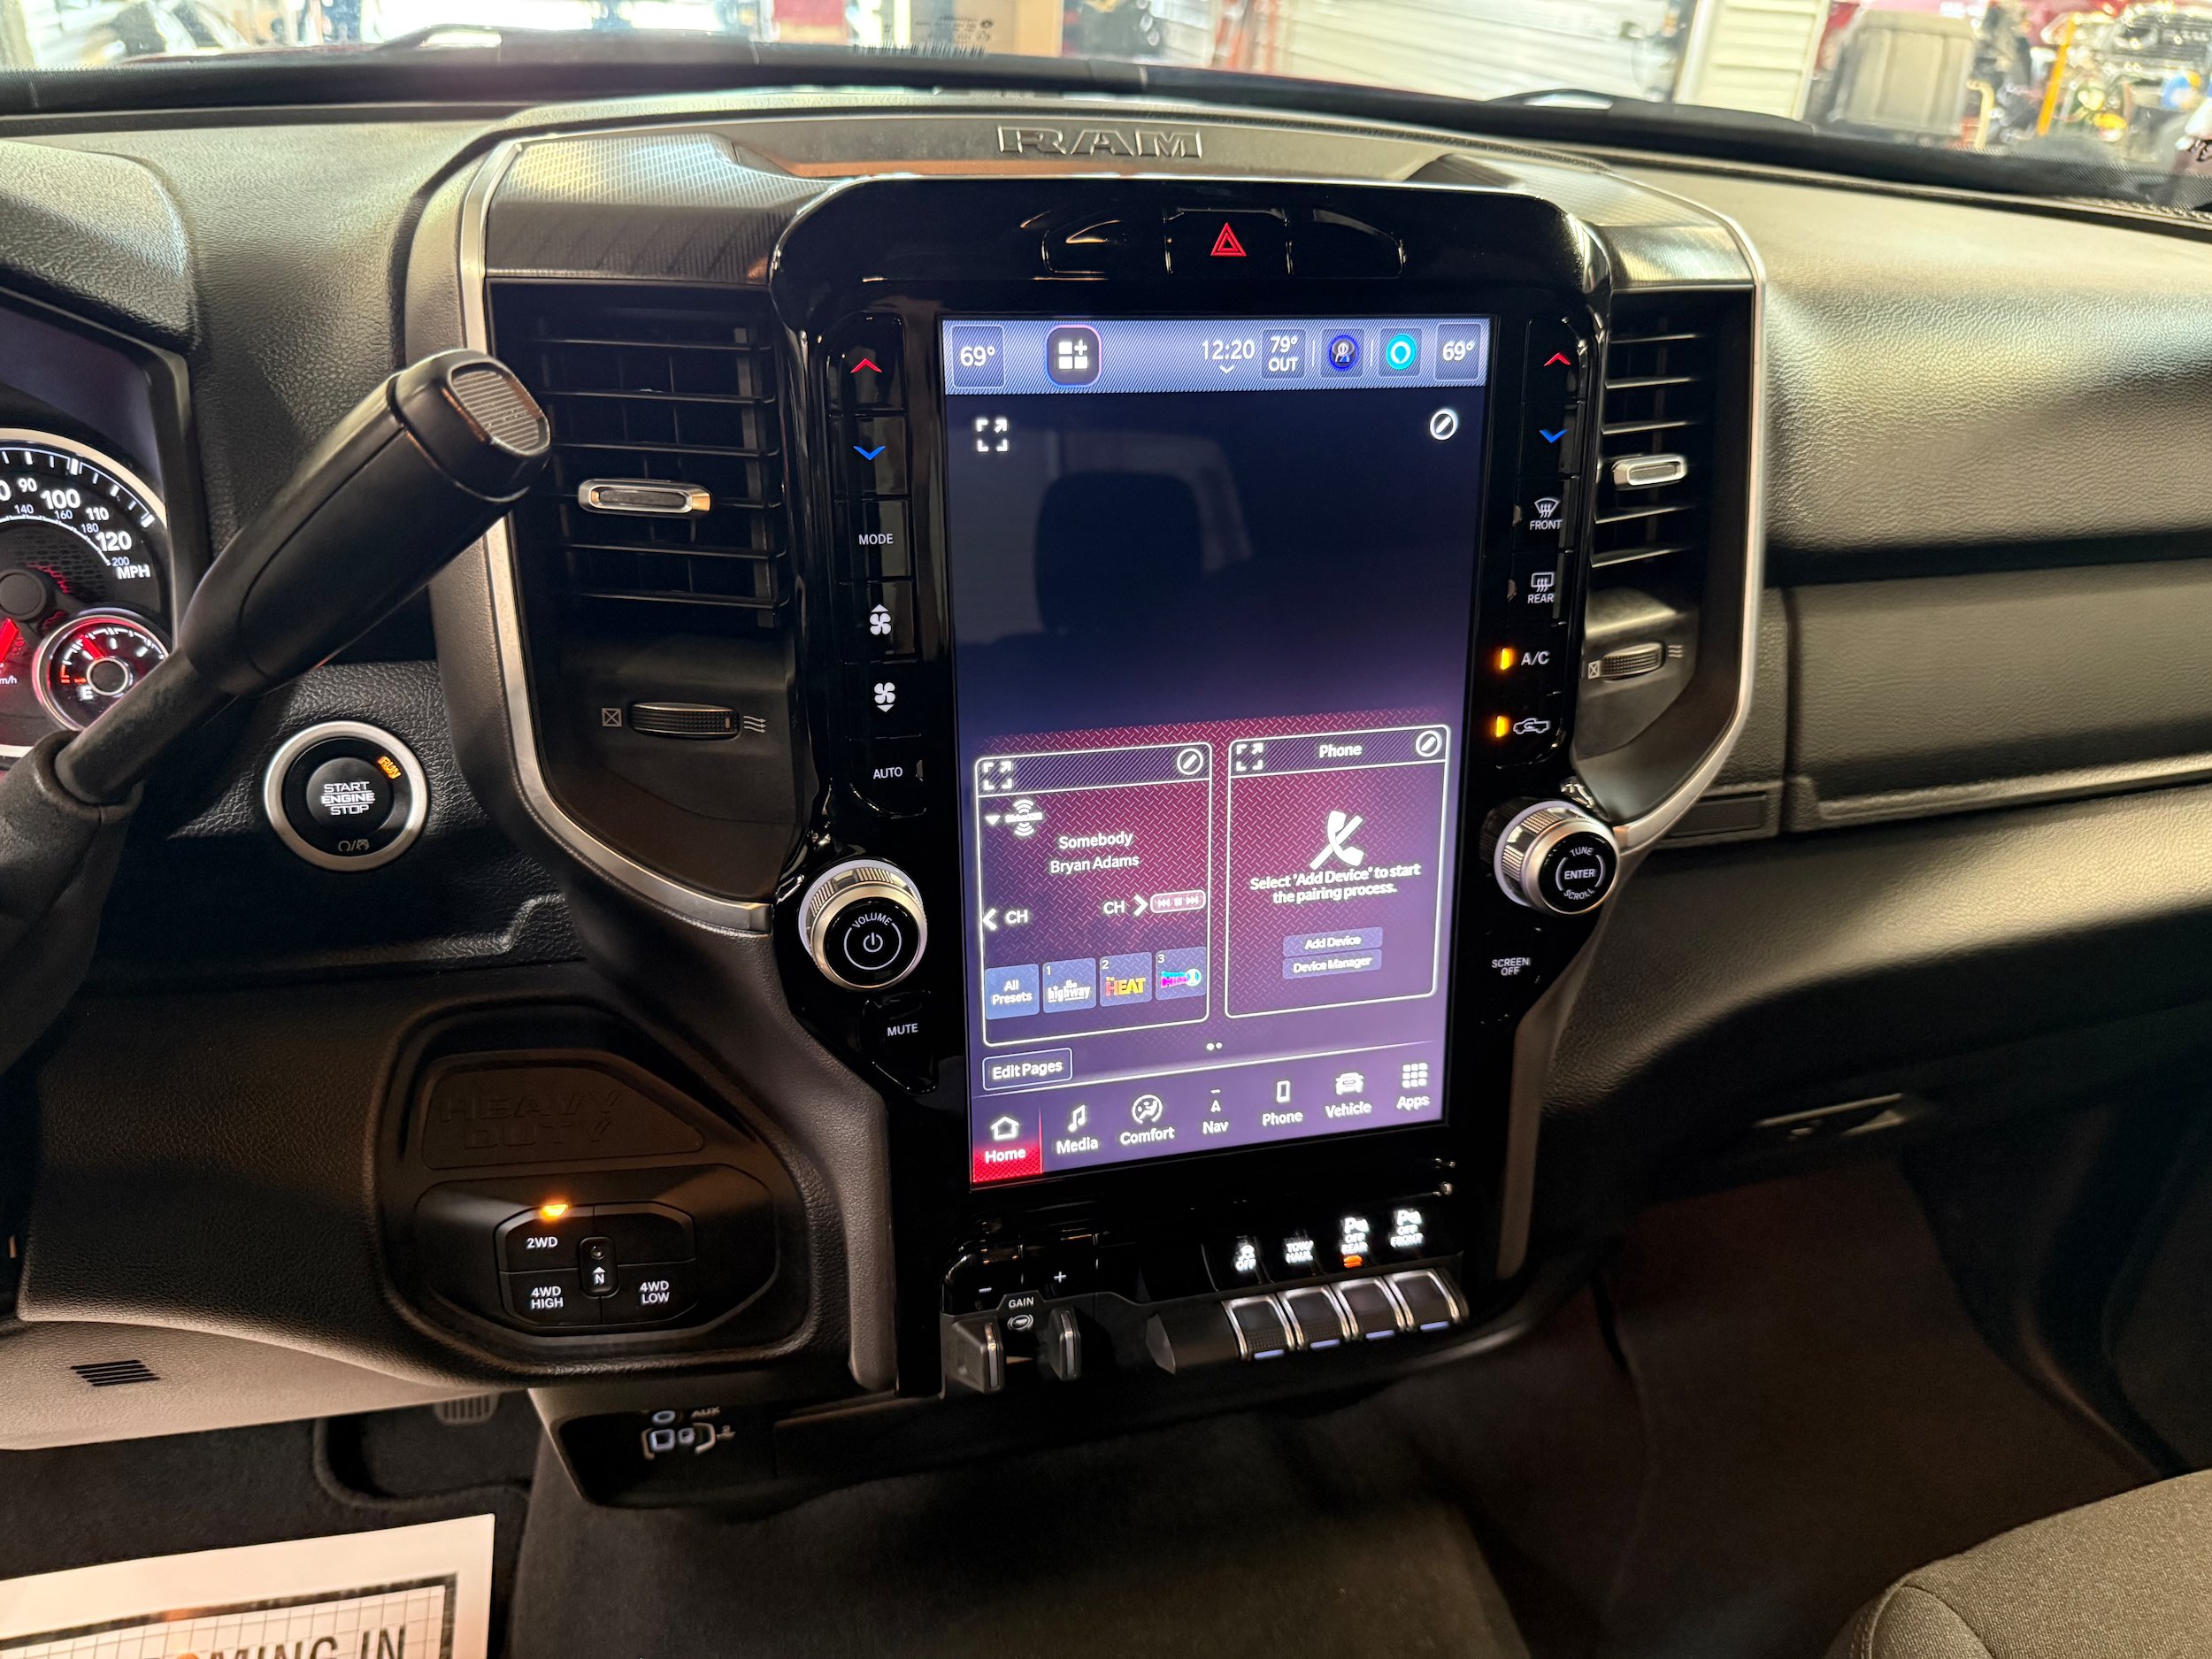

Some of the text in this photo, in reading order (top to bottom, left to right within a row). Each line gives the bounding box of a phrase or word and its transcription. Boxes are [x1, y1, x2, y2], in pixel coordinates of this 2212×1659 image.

[997, 125, 1203, 158] RAM
[1202, 339, 1256, 361] 12:20
[1270, 335, 1298, 353] 79°
[1442, 340, 1475, 361] 69°
[960, 343, 996, 367] 69°
[1268, 357, 1299, 373] OUT
[18, 477, 37, 492] 90
[41, 488, 81, 510] 100
[14, 504, 34, 514] 140
[55, 510, 73, 520] 160
[86, 507, 110, 520] 110
[81, 523, 99, 533] 180
[1530, 519, 1563, 531] FRONT
[96, 531, 132, 552] 120
[858, 533, 895, 545] MODE
[112, 557, 130, 566] 200
[116, 565, 150, 580] MPH
[1527, 593, 1555, 604] REAR
[1521, 649, 1550, 666] A/C
[81, 686, 94, 701] E
[1318, 743, 1363, 758] Phone
[377, 756, 402, 780] RUN
[873, 766, 903, 780] AUTO
[324, 781, 370, 793] START
[321, 793, 375, 804] ENGINE
[331, 804, 369, 815] STOP
[1058, 831, 1133, 850] Somebody
[1569, 846, 1594, 857] TUNE
[1049, 855, 1140, 875] Bryan Adams
[1249, 864, 1422, 890] Select 'Add Device' to start
[1563, 868, 1596, 880] ENTER
[1272, 883, 1398, 904] the pairing process.
[1563, 887, 1595, 901] SCROLL
[1103, 900, 1126, 915] CH
[851, 912, 893, 929] VOLUME
[1004, 910, 1029, 925] CH
[1304, 934, 1363, 950] Add Device
[1102, 959, 1110, 970] 2
[1157, 954, 1165, 964] 3
[1293, 956, 1373, 973] Device Manager
[1491, 956, 1531, 968] SCREEN
[1046, 965, 1051, 976] 1
[1501, 966, 1521, 976] OFF
[1004, 979, 1019, 992] All
[1105, 977, 1147, 997] HEAT
[991, 991, 1033, 1005] Presets
[1048, 985, 1091, 1002] highway
[887, 1023, 918, 1036] MUTE
[992, 1061, 1063, 1080] Edit Pages
[1325, 1101, 1372, 1118] Vehicle
[1395, 1095, 1431, 1111] Apps
[1262, 1111, 1303, 1127] Phone
[1202, 1120, 1229, 1134] Nav
[1119, 1126, 1176, 1146] Comfort
[1056, 1137, 1099, 1155] Media
[984, 1148, 1026, 1164] Home
[526, 1235, 558, 1249] 2WD
[1390, 1233, 1425, 1248] FRONT
[1341, 1241, 1369, 1255] REAR
[1285, 1250, 1314, 1263] HAUL
[594, 1273, 605, 1285] N
[531, 1286, 562, 1298] 4WD
[640, 1280, 670, 1293] 4WD
[531, 1296, 564, 1310] HIGH
[641, 1292, 670, 1305] LOW
[1008, 1296, 1034, 1309] GAIN
